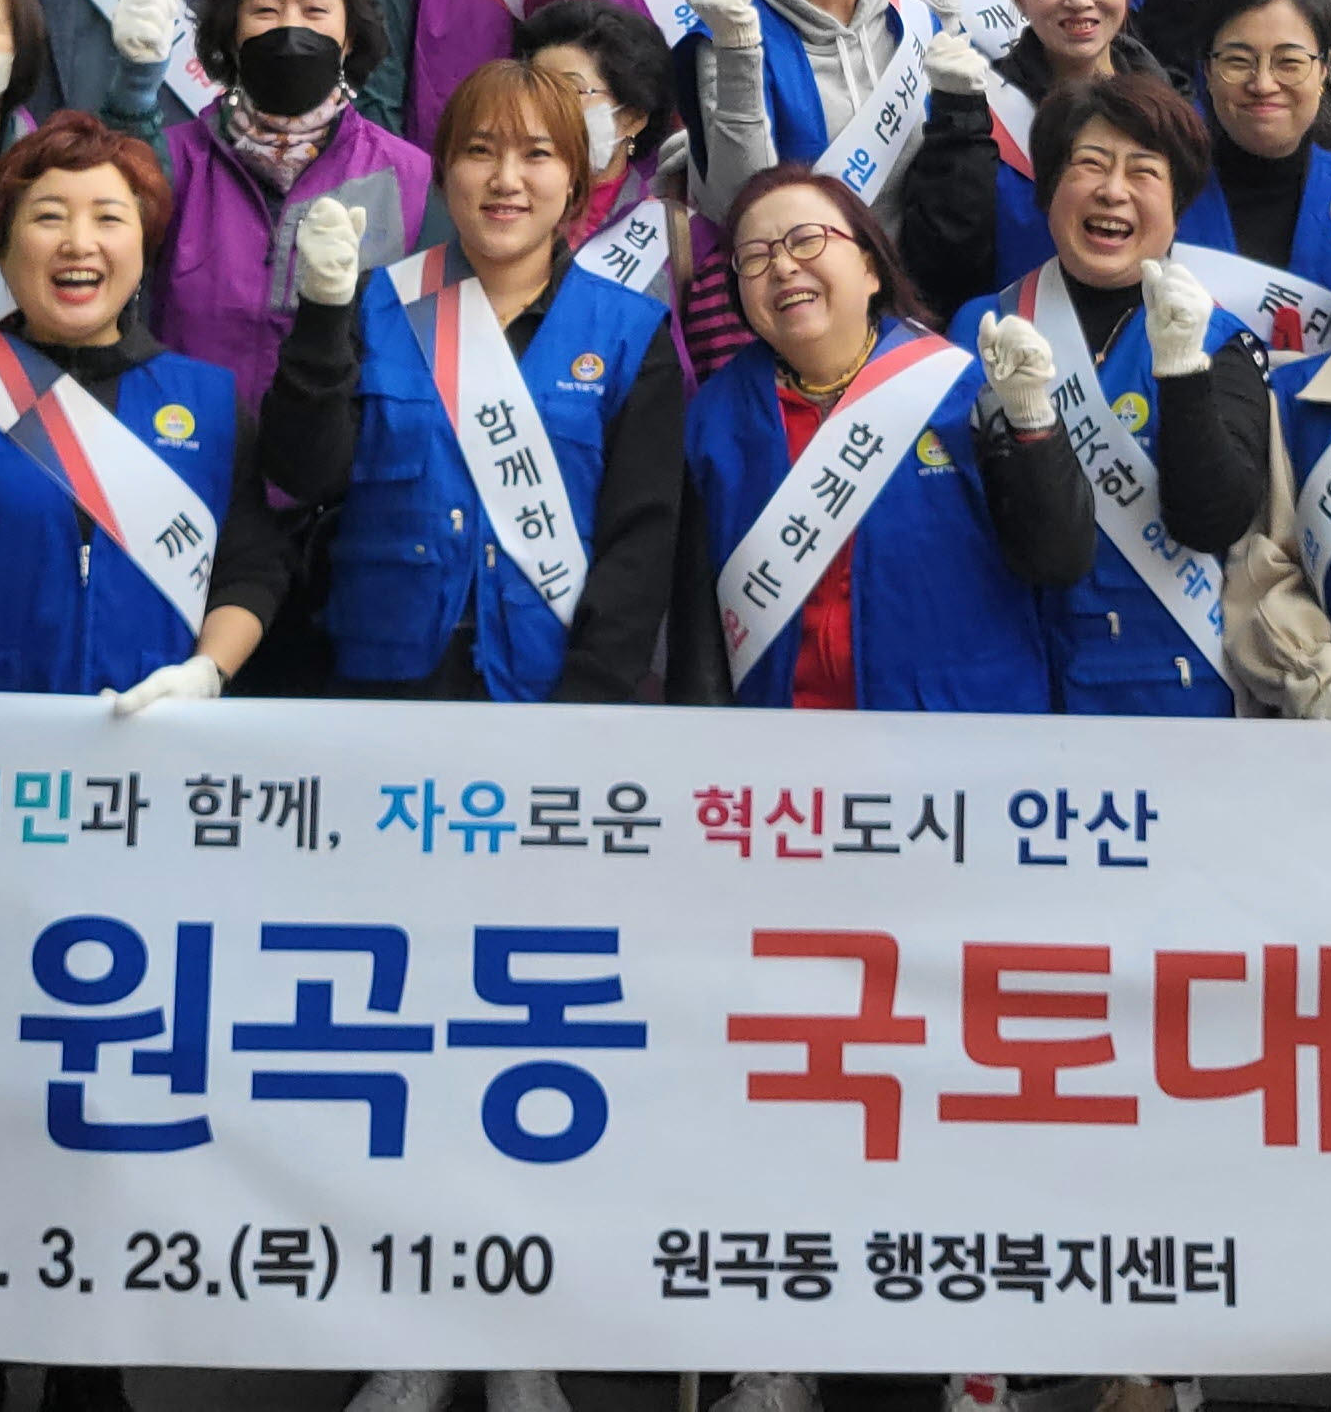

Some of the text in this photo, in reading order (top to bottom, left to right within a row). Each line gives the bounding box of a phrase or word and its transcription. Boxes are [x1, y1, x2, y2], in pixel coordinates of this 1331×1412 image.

[602, 218, 658, 284] 함께
[475, 399, 570, 601] 함께하는
[1052, 374, 1143, 508] 깨끗한
[743, 422, 884, 608] 함께하는
[185, 774, 340, 851] 함께,
[376, 779, 662, 855] 자유로운
[693, 786, 966, 864] 혁신도시
[1008, 788, 1159, 868] 안산
[19, 915, 648, 1165] 원곡동
[38, 1227, 93, 1294] 3.
[124, 1224, 339, 1301] 23.(목)
[371, 1234, 554, 1296] 11:00
[652, 1229, 839, 1302] 원곡동
[865, 1231, 1237, 1308] 행정복지센터
